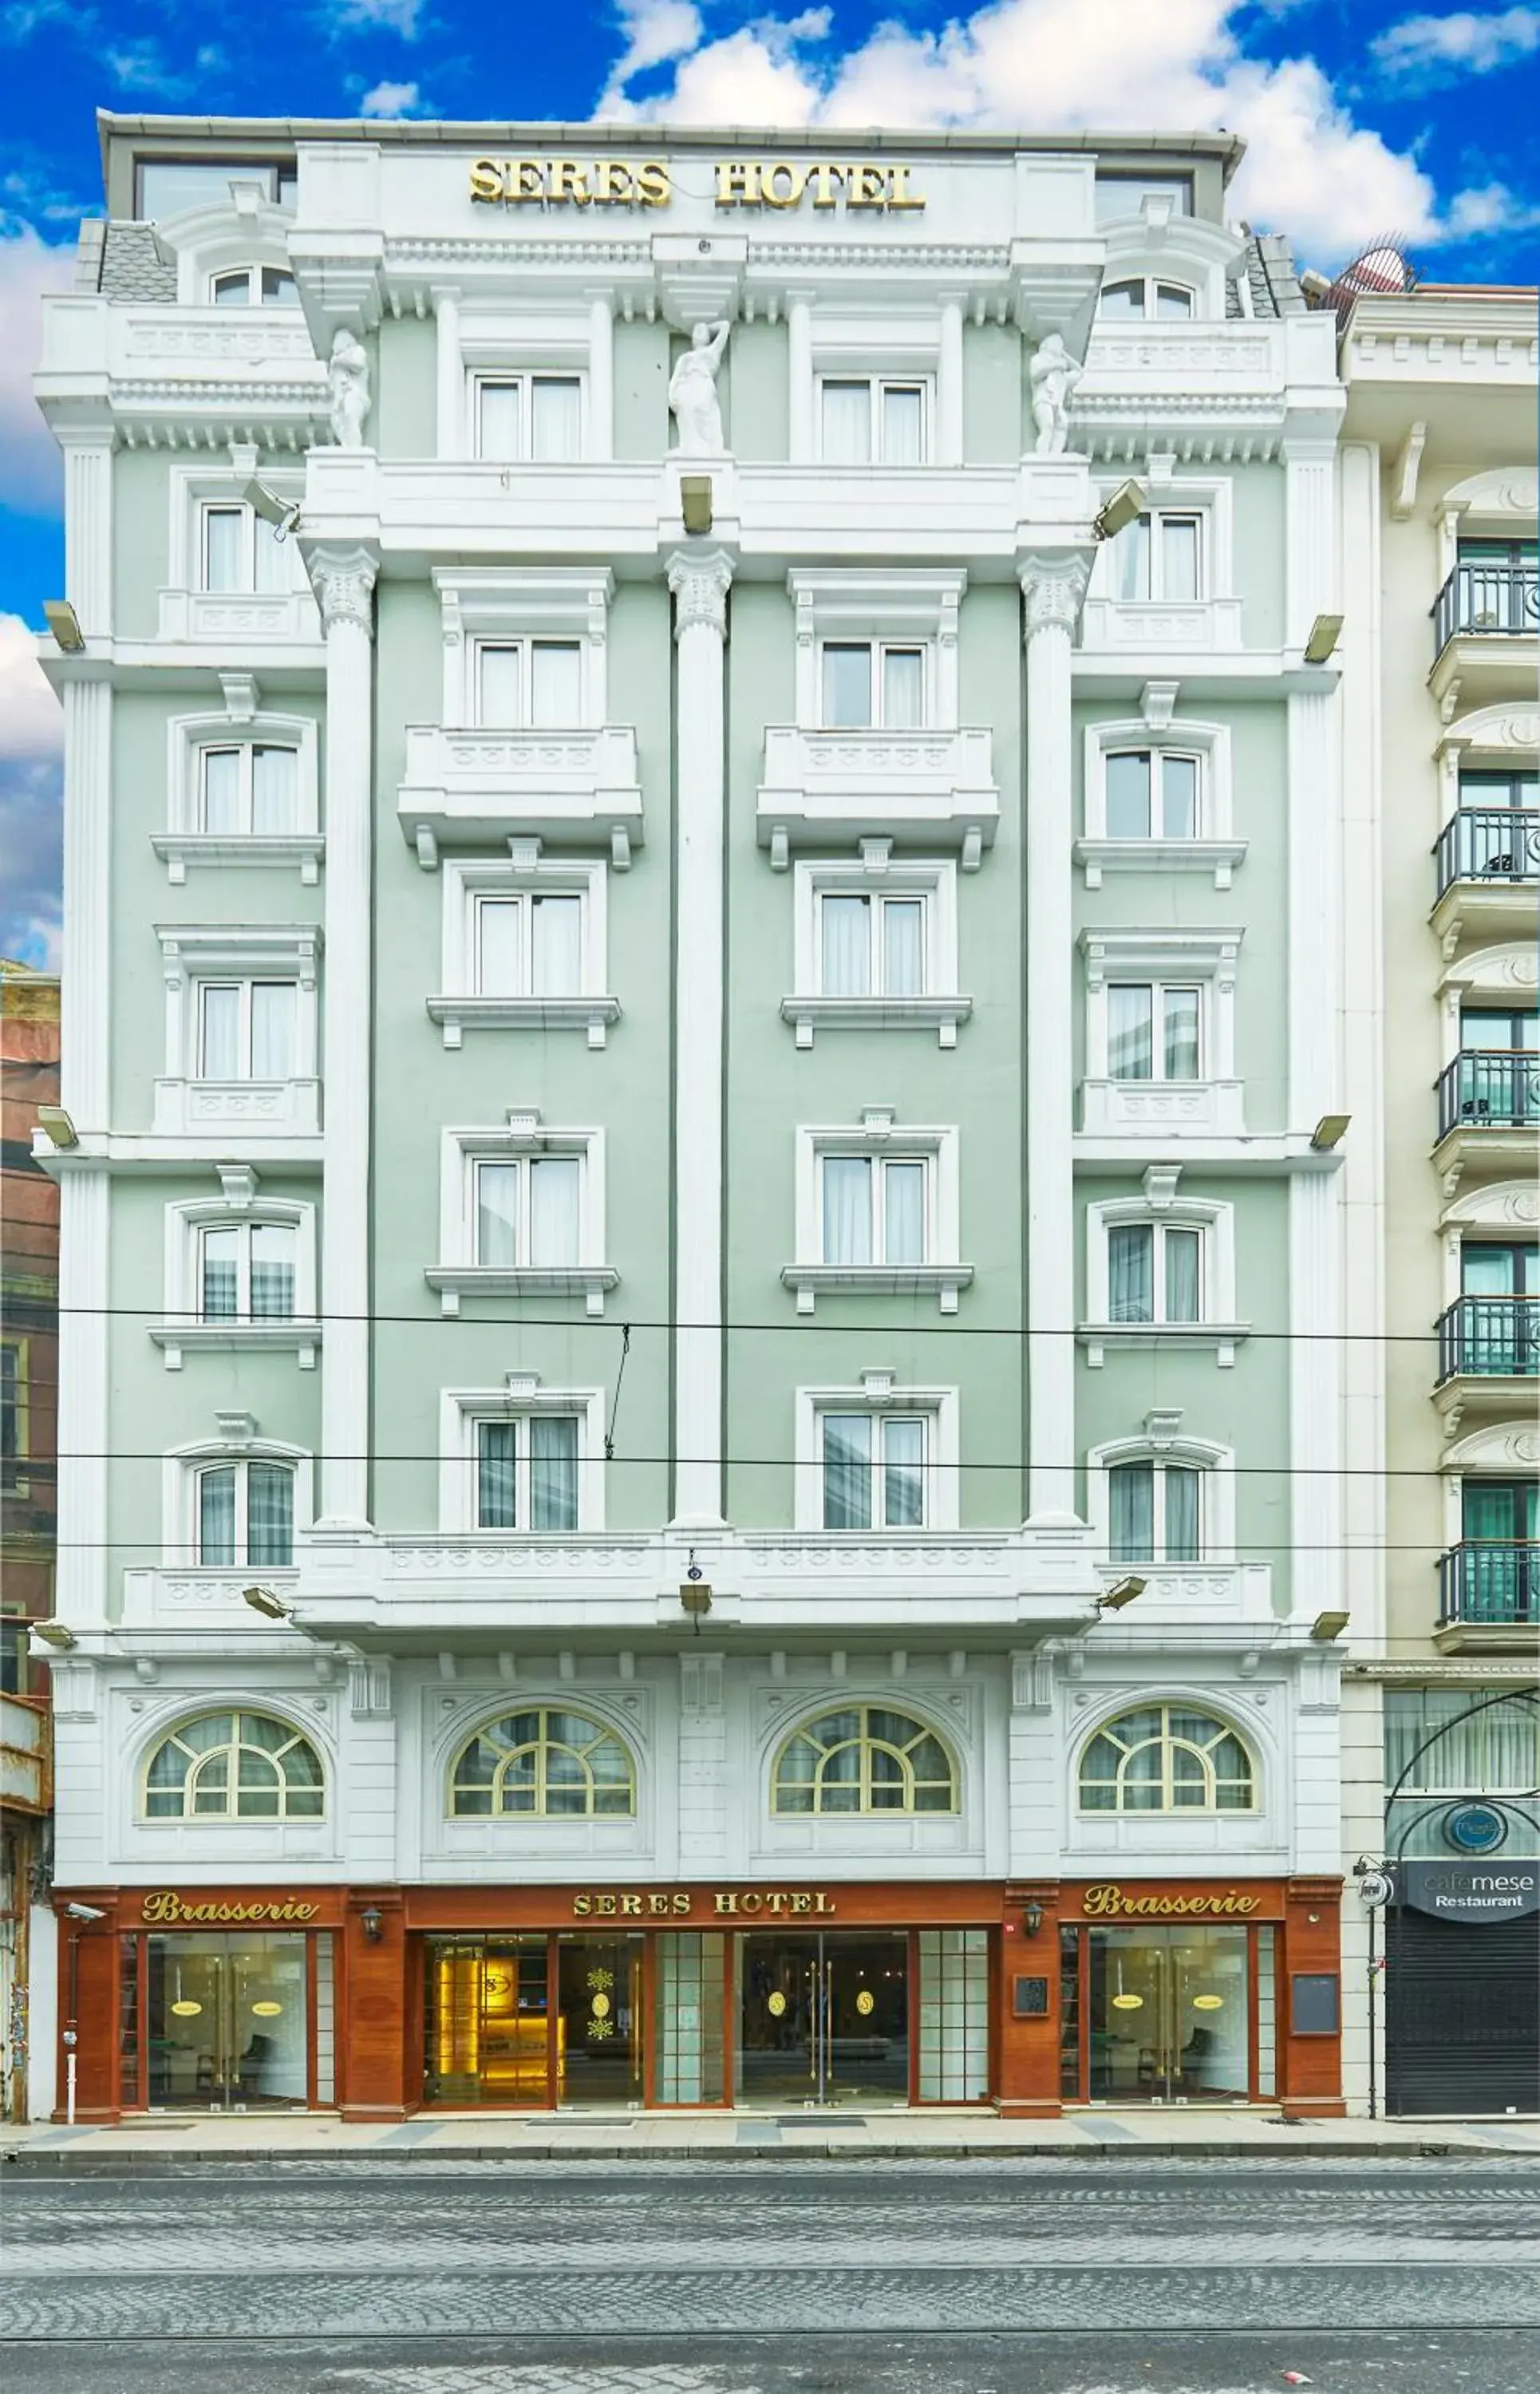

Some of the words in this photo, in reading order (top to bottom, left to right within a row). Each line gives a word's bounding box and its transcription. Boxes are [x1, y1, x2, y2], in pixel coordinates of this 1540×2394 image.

[469, 159, 671, 206] SERES
[714, 161, 926, 211] HOTEL
[141, 1890, 320, 1922] Brasserie
[574, 1894, 691, 1915] SERES
[714, 1893, 835, 1914] HOTEL
[1083, 1884, 1262, 1914] Brasserie
[1435, 1895, 1523, 1907] Restaurant
